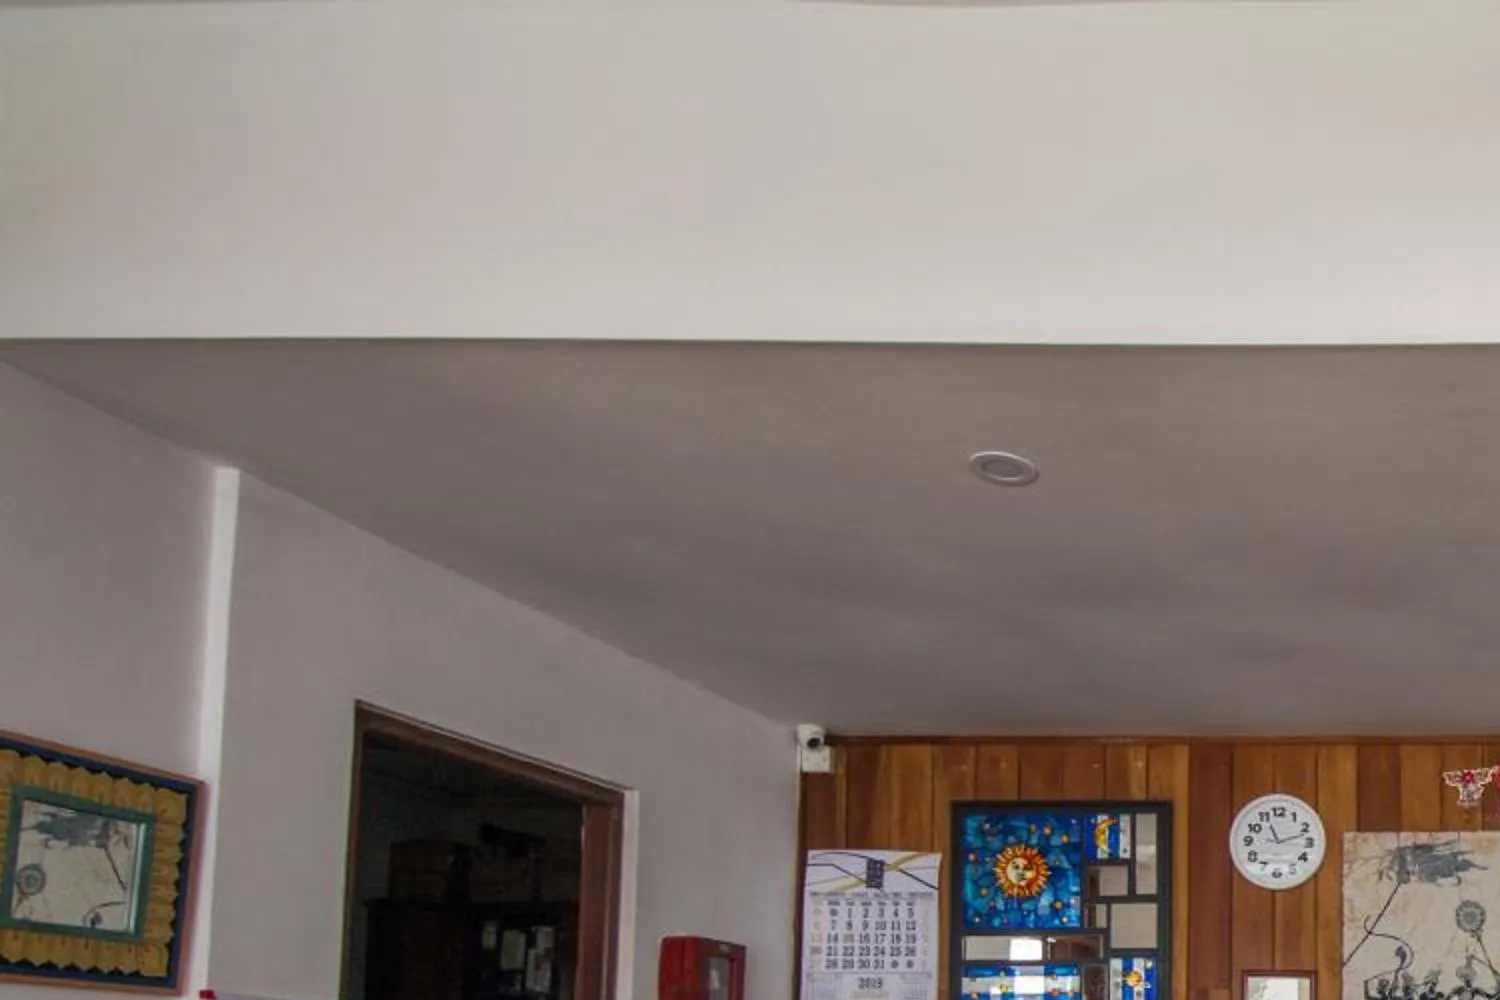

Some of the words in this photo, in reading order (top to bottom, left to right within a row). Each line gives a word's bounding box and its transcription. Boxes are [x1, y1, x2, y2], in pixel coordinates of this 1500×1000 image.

[1259, 811, 1270, 822] 11
[1271, 806, 1286, 817] 12
[1291, 811, 1297, 823] 1
[1248, 823, 1262, 834] 10
[1300, 822, 1310, 833] 2
[1243, 835, 1254, 847] 9
[1304, 837, 1314, 848] 3
[1247, 850, 1258, 863] 8
[1298, 852, 1309, 863] 4
[1259, 861, 1269, 871] 7
[1288, 863, 1297, 875] 5
[1272, 867, 1283, 879] 6
